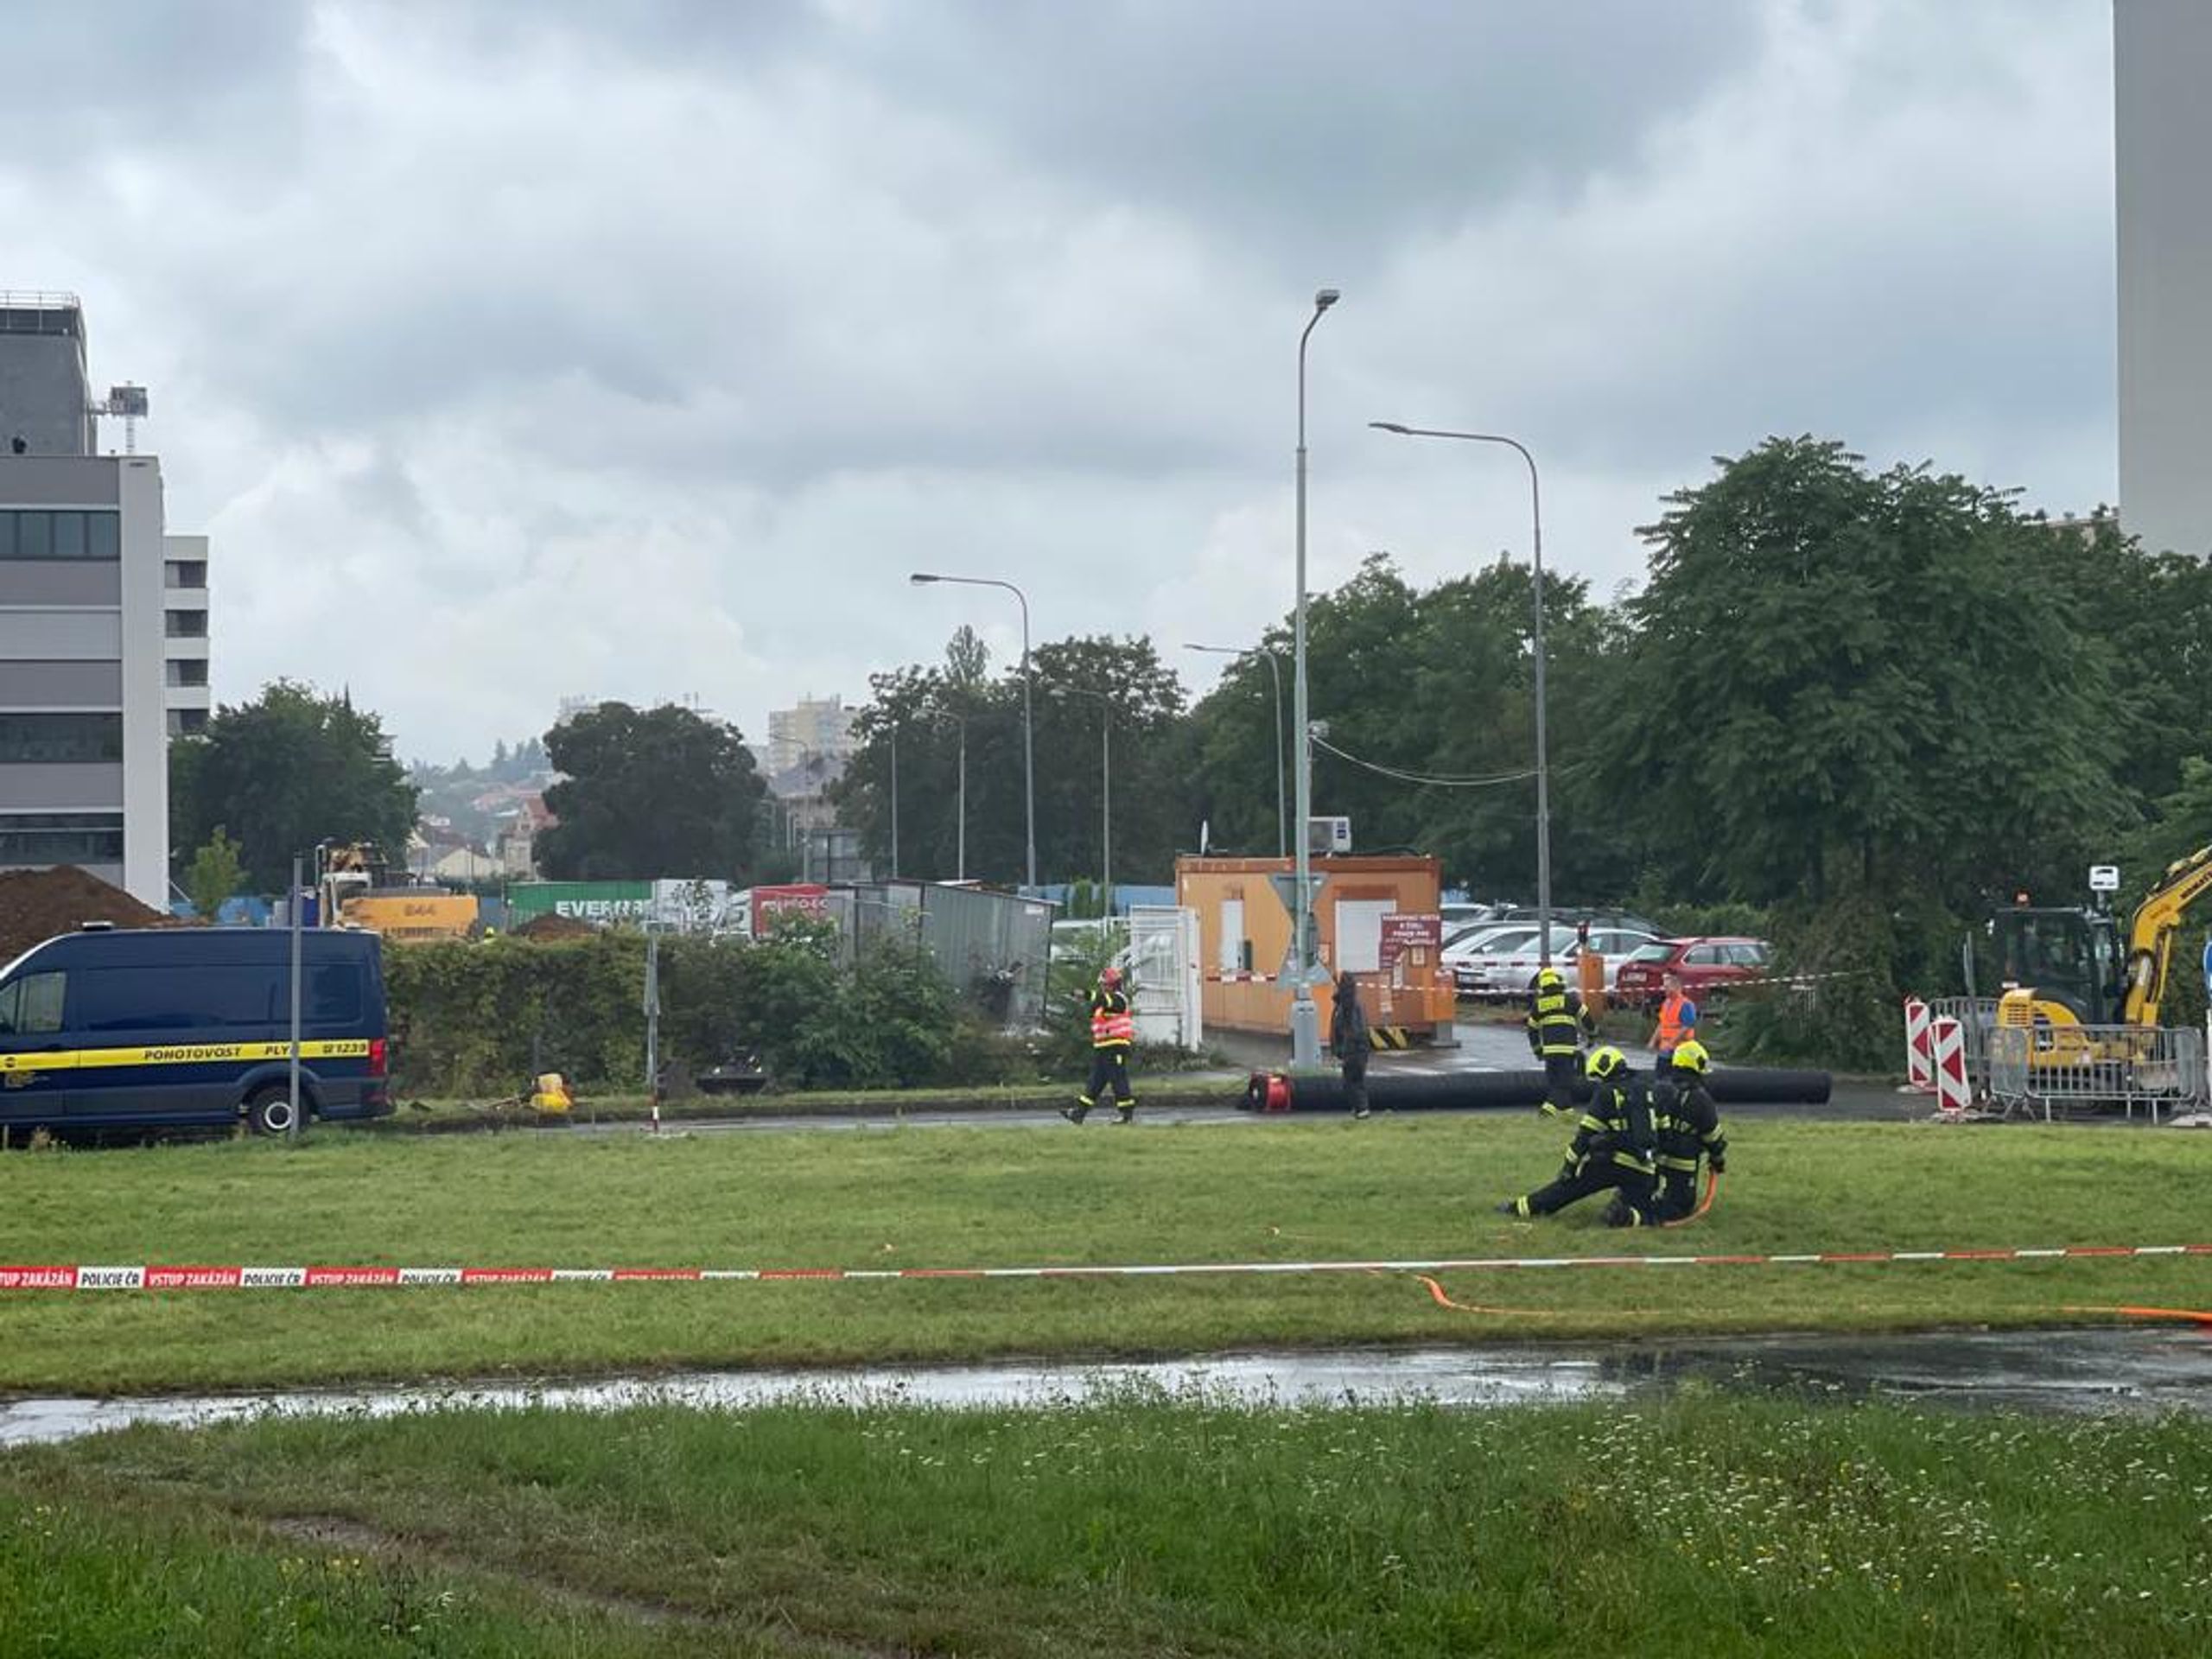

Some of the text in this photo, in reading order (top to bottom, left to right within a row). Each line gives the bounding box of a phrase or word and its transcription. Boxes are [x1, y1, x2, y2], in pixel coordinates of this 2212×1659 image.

[144, 1046, 241, 1060] POHOTOVOST
[264, 1046, 292, 1056] PLY
[22, 1269, 74, 1287] ZAKÁZÁN
[82, 1272, 123, 1286] POLICIE
[125, 1271, 139, 1286] ČR
[149, 1273, 184, 1286] VSTUP
[186, 1270, 237, 1286] ZAKÁZÁN
[244, 1274, 284, 1285] POLICIE
